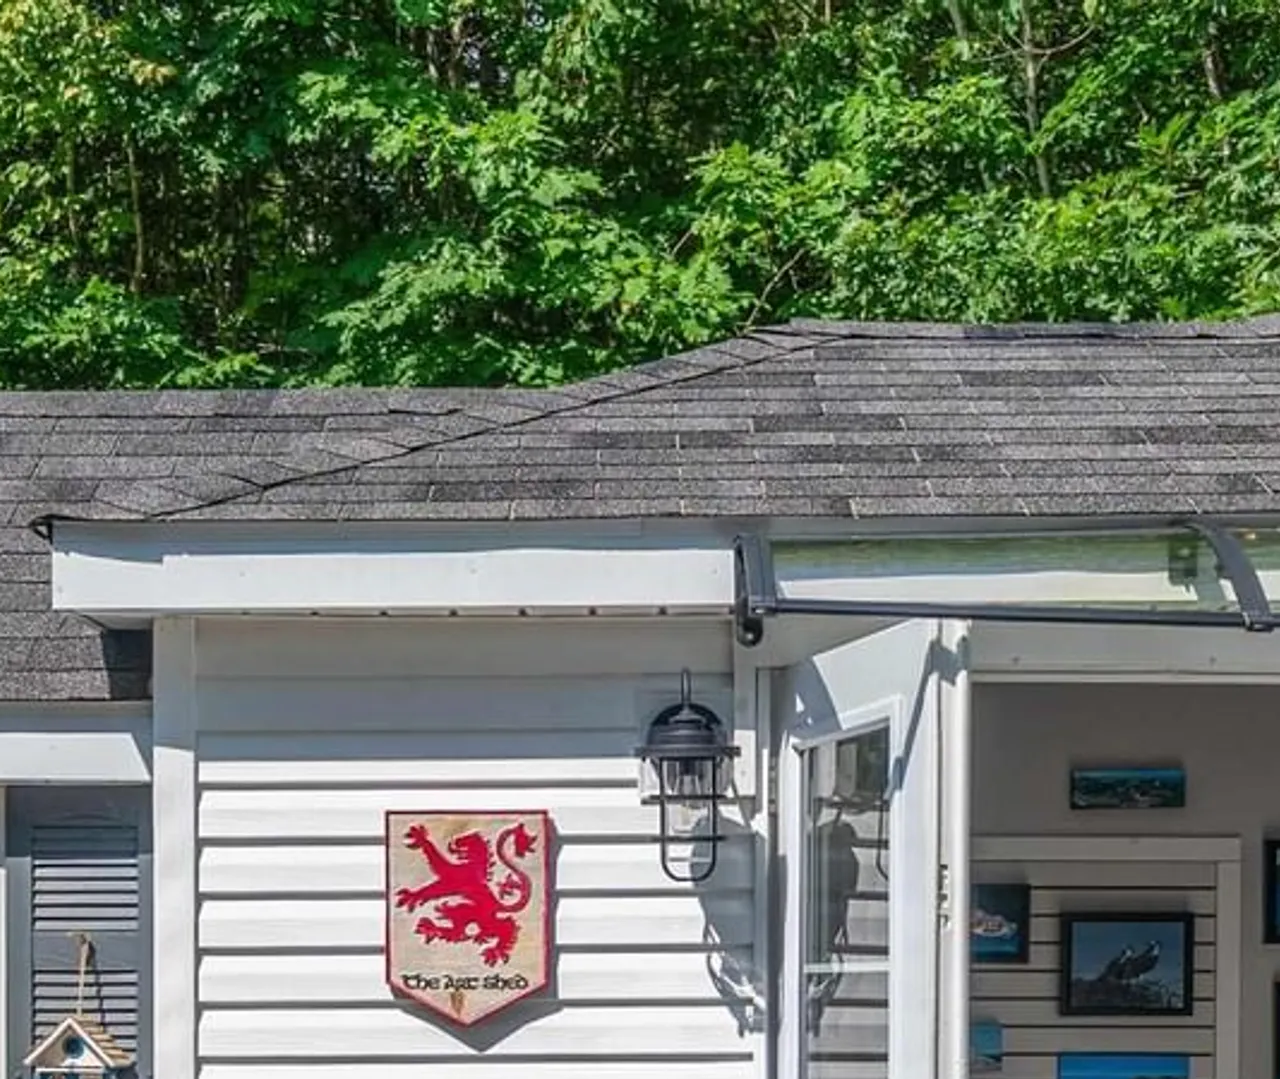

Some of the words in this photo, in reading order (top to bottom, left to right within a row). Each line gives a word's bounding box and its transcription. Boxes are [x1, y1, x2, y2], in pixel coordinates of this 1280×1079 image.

[401, 973, 440, 991] The
[442, 974, 479, 992] Art
[483, 973, 529, 991] Shed
